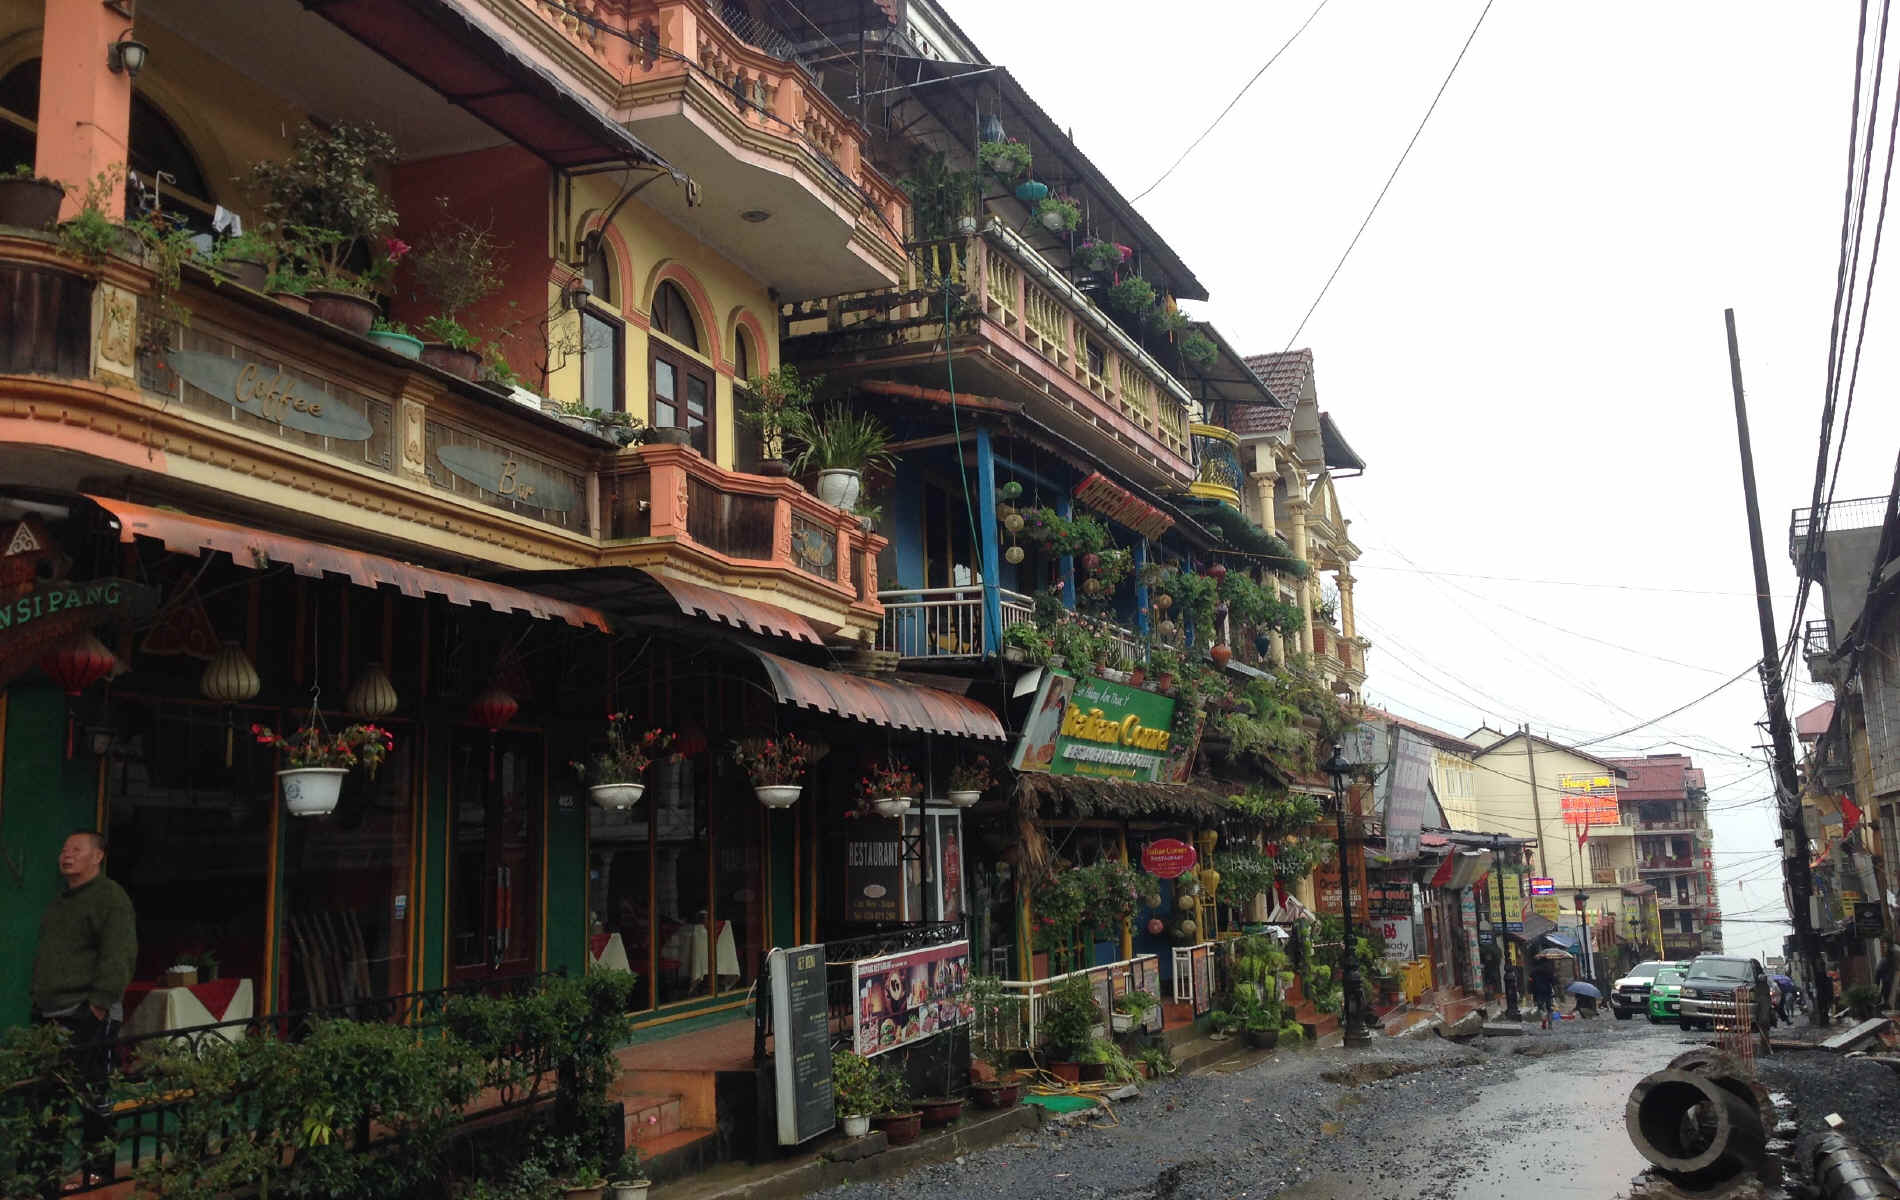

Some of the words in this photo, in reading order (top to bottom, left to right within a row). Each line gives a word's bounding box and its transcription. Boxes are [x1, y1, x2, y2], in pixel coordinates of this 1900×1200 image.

[235, 363, 322, 423] Coffee
[498, 459, 536, 500] Bar
[848, 842, 899, 867] RESTAURANT
